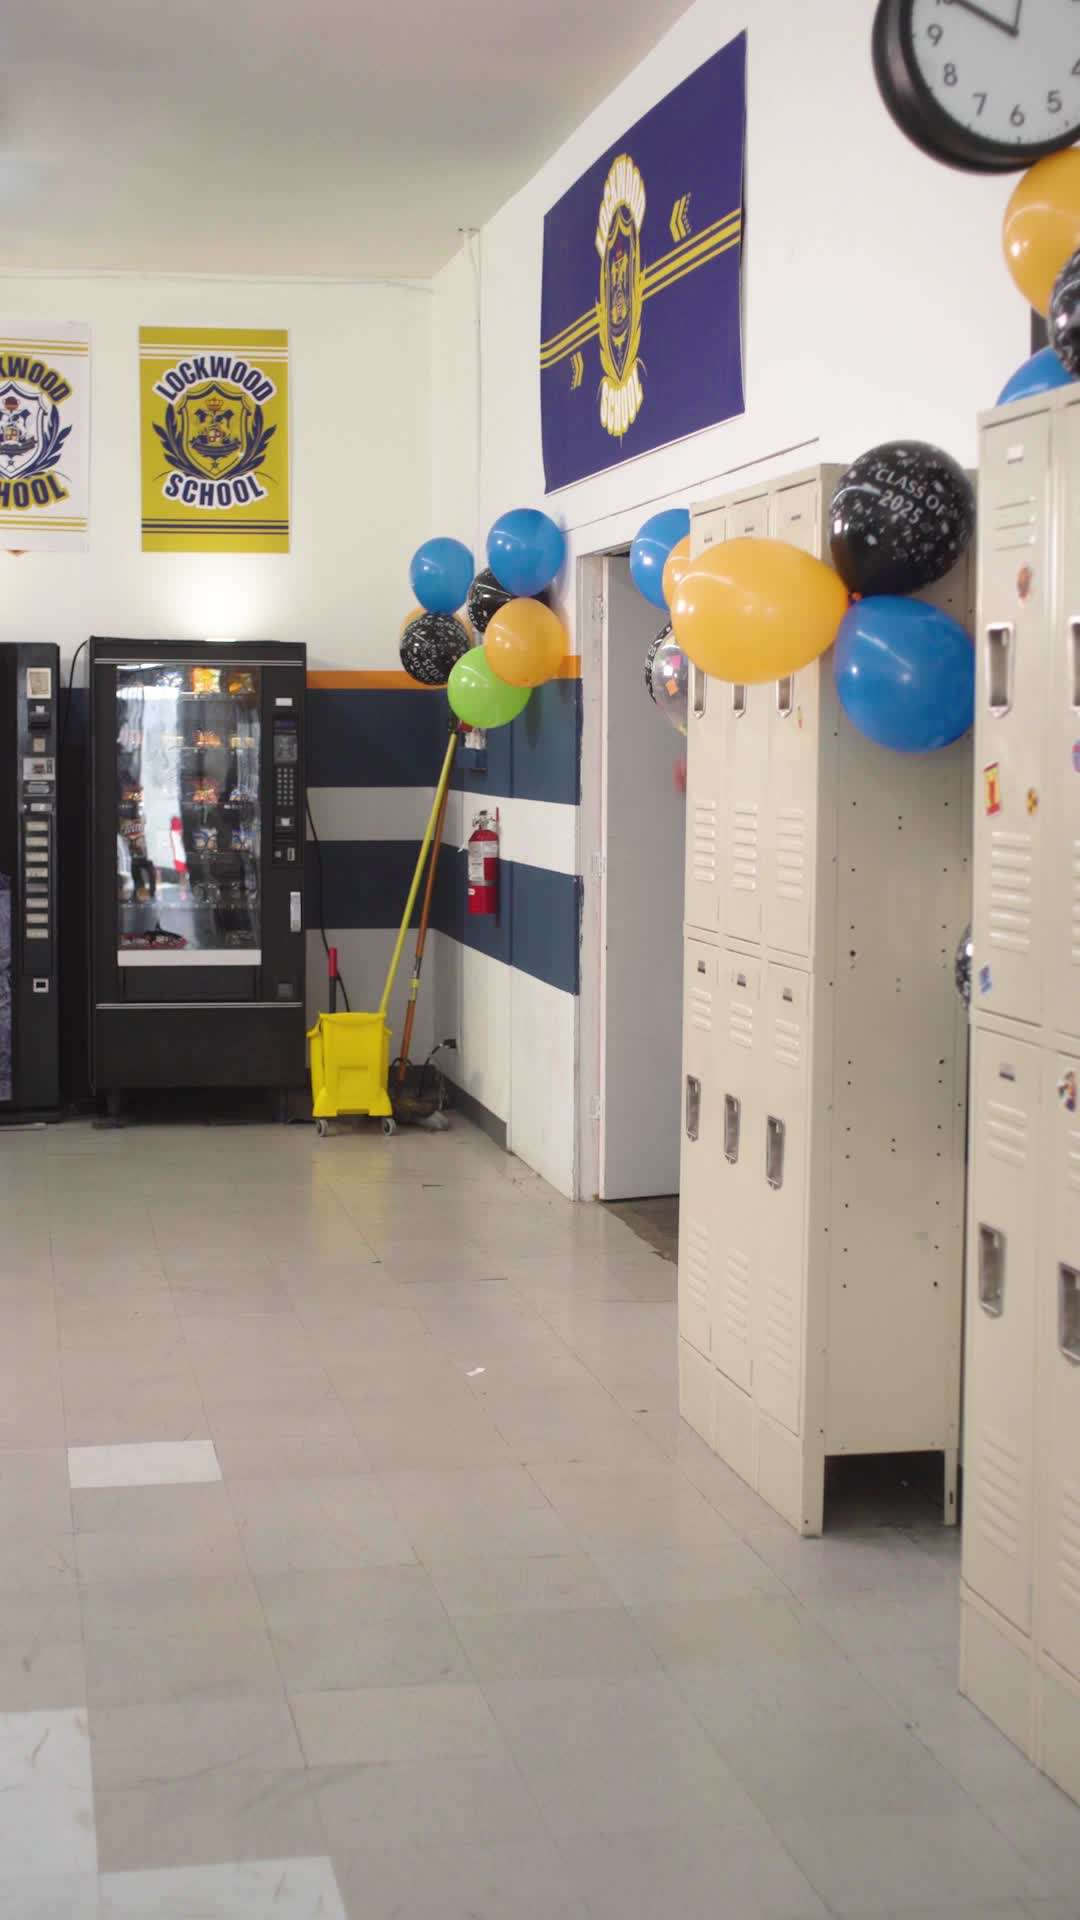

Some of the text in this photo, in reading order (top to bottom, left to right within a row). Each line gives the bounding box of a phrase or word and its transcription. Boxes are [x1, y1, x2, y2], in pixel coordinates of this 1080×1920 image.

[927, 23, 944, 47] 9
[943, 62, 958, 87] 8
[973, 92, 988, 116] 7
[1047, 90, 1063, 113] 5
[1009, 104, 1025, 127] 6
[156, 355, 273, 401] LOCKWOOD
[165, 473, 264, 506] SCHOOL
[875, 468, 948, 516] CLASS OF
[878, 489, 923, 524] 2025
